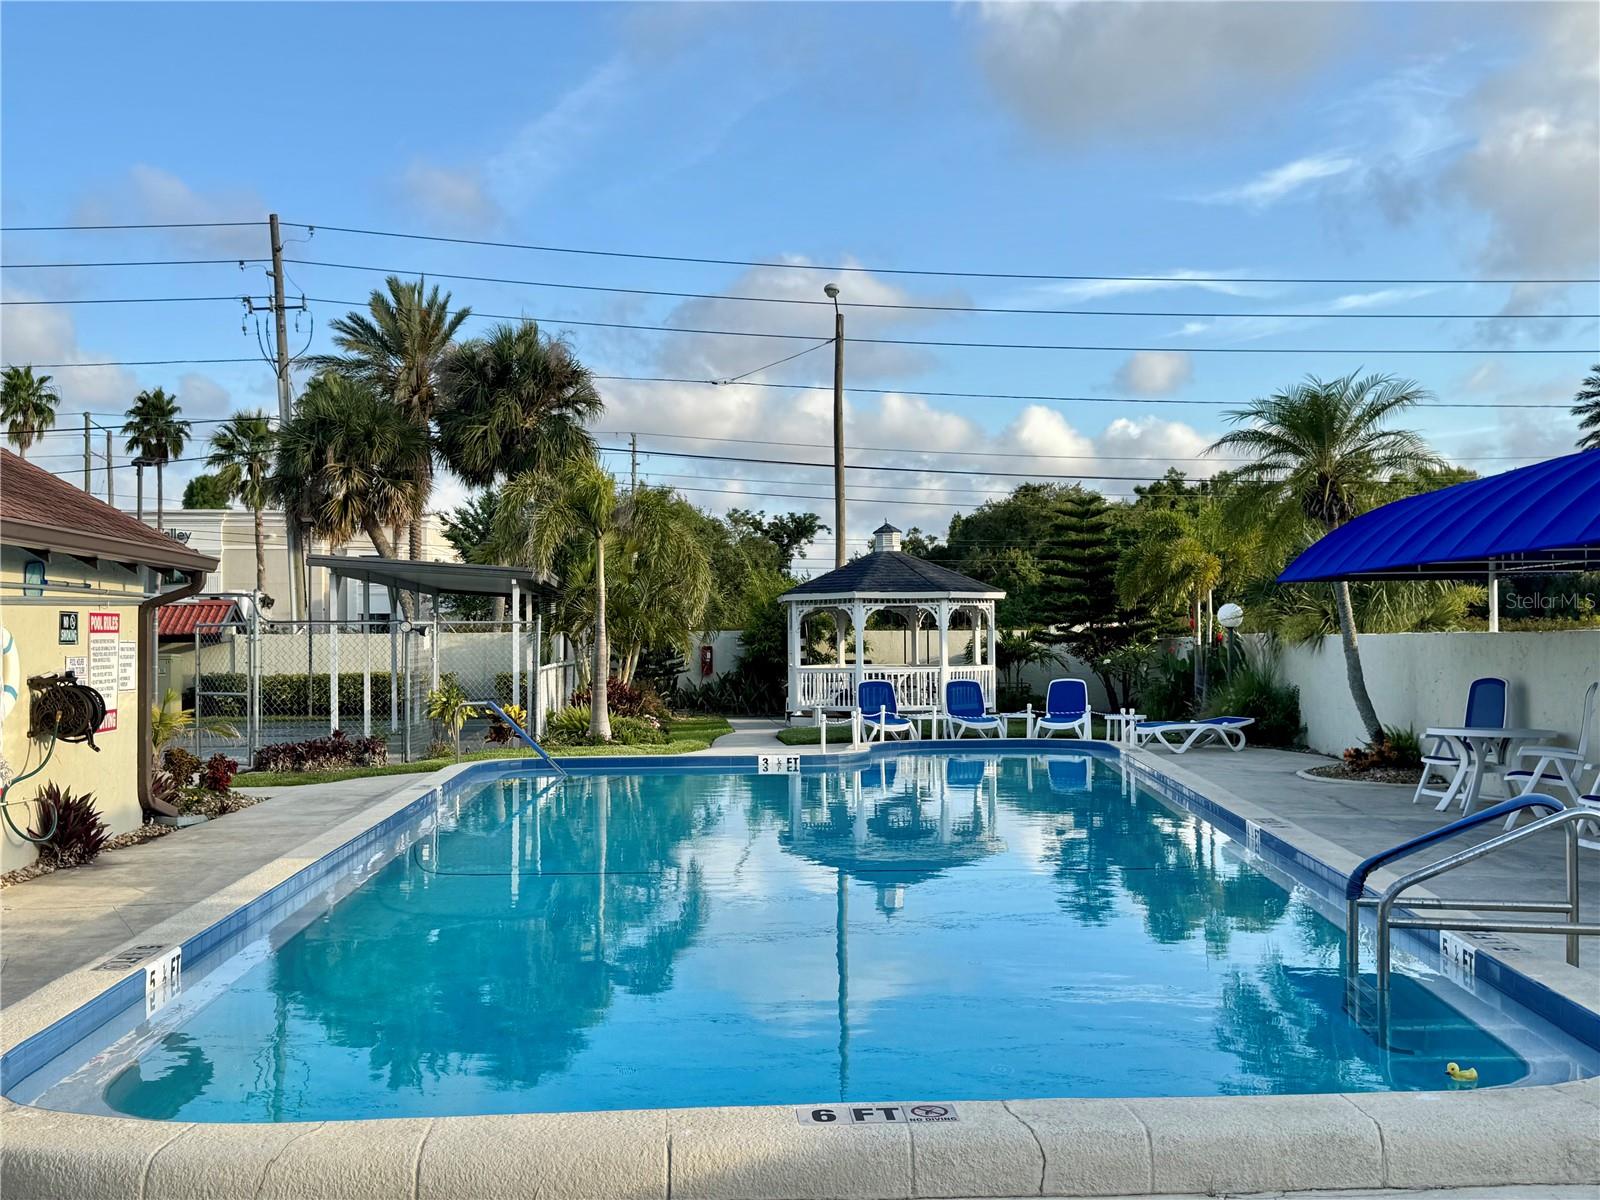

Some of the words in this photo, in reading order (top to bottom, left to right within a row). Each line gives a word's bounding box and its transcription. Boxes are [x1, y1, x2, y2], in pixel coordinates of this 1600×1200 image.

[63, 615, 69, 628] NO
[90, 615, 103, 631] POOL
[103, 615, 119, 631] RULES
[1443, 937, 1449, 956] 5
[1463, 948, 1474, 970] FT
[150, 969, 156, 988] 5
[811, 1109, 837, 1123] 6
[852, 1107, 899, 1122] FT
